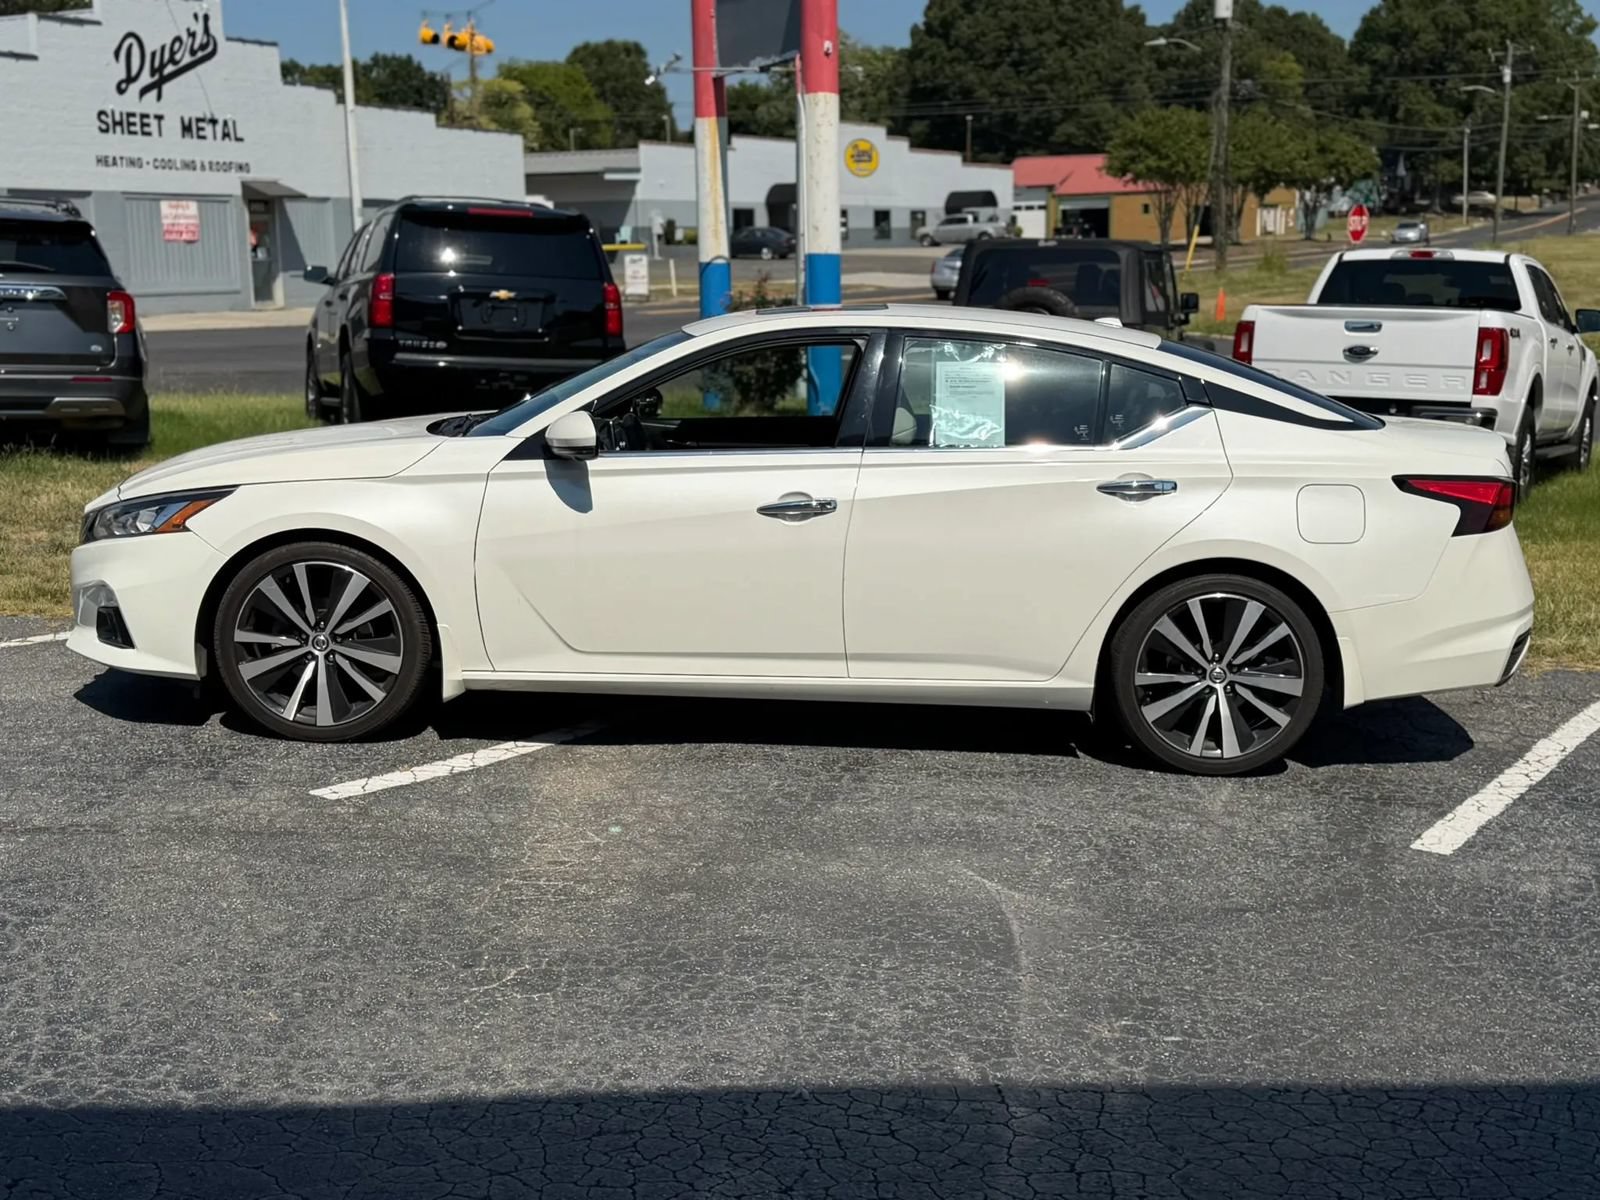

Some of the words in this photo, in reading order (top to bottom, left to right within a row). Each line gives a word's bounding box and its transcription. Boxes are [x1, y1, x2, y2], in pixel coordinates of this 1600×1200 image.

[113, 12, 218, 103] Dyer's
[97, 109, 165, 138] SHEET
[180, 115, 245, 143] METAL
[96, 155, 144, 169] HEATING
[152, 158, 197, 172] COOLING
[200, 161, 206, 172] &
[208, 161, 251, 174] ROOFING
[1350, 215, 1367, 231] STOP
